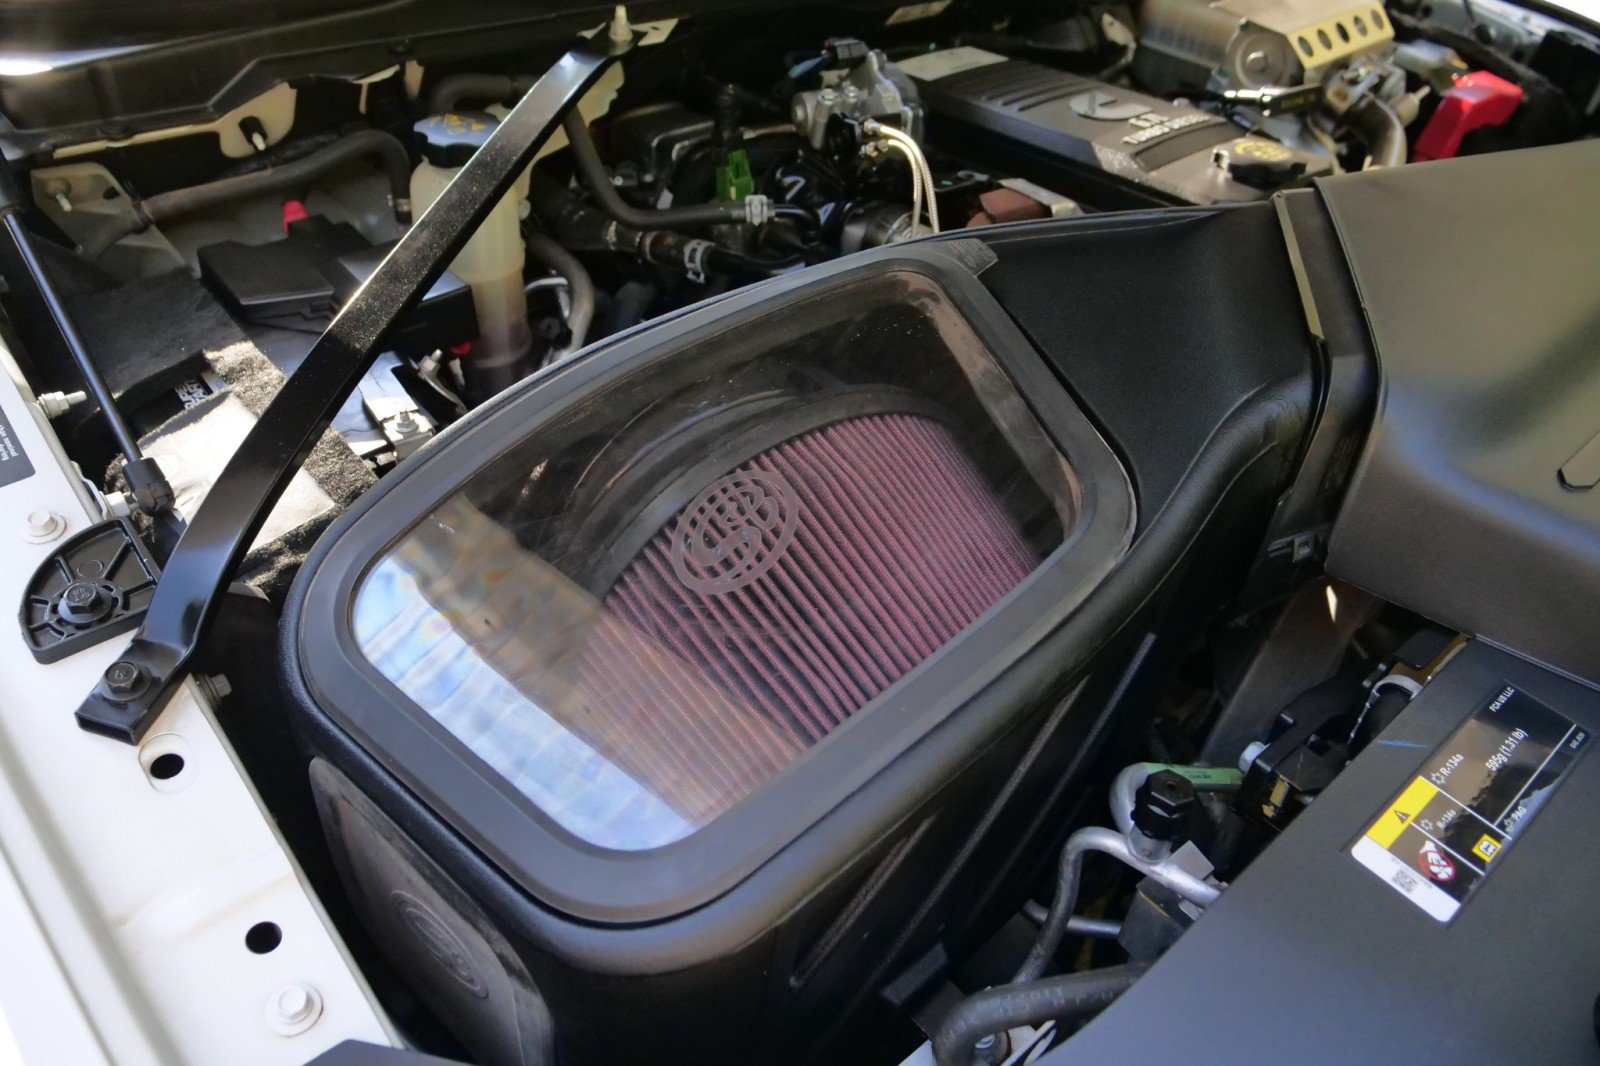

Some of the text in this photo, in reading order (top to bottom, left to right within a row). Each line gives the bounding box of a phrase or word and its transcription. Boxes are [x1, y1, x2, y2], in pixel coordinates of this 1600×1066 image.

[1489, 700, 1502, 713] FCA
[1503, 687, 1515, 698] LLC
[1440, 753, 1464, 777] R-134a
[1486, 751, 1507, 771] 595g
